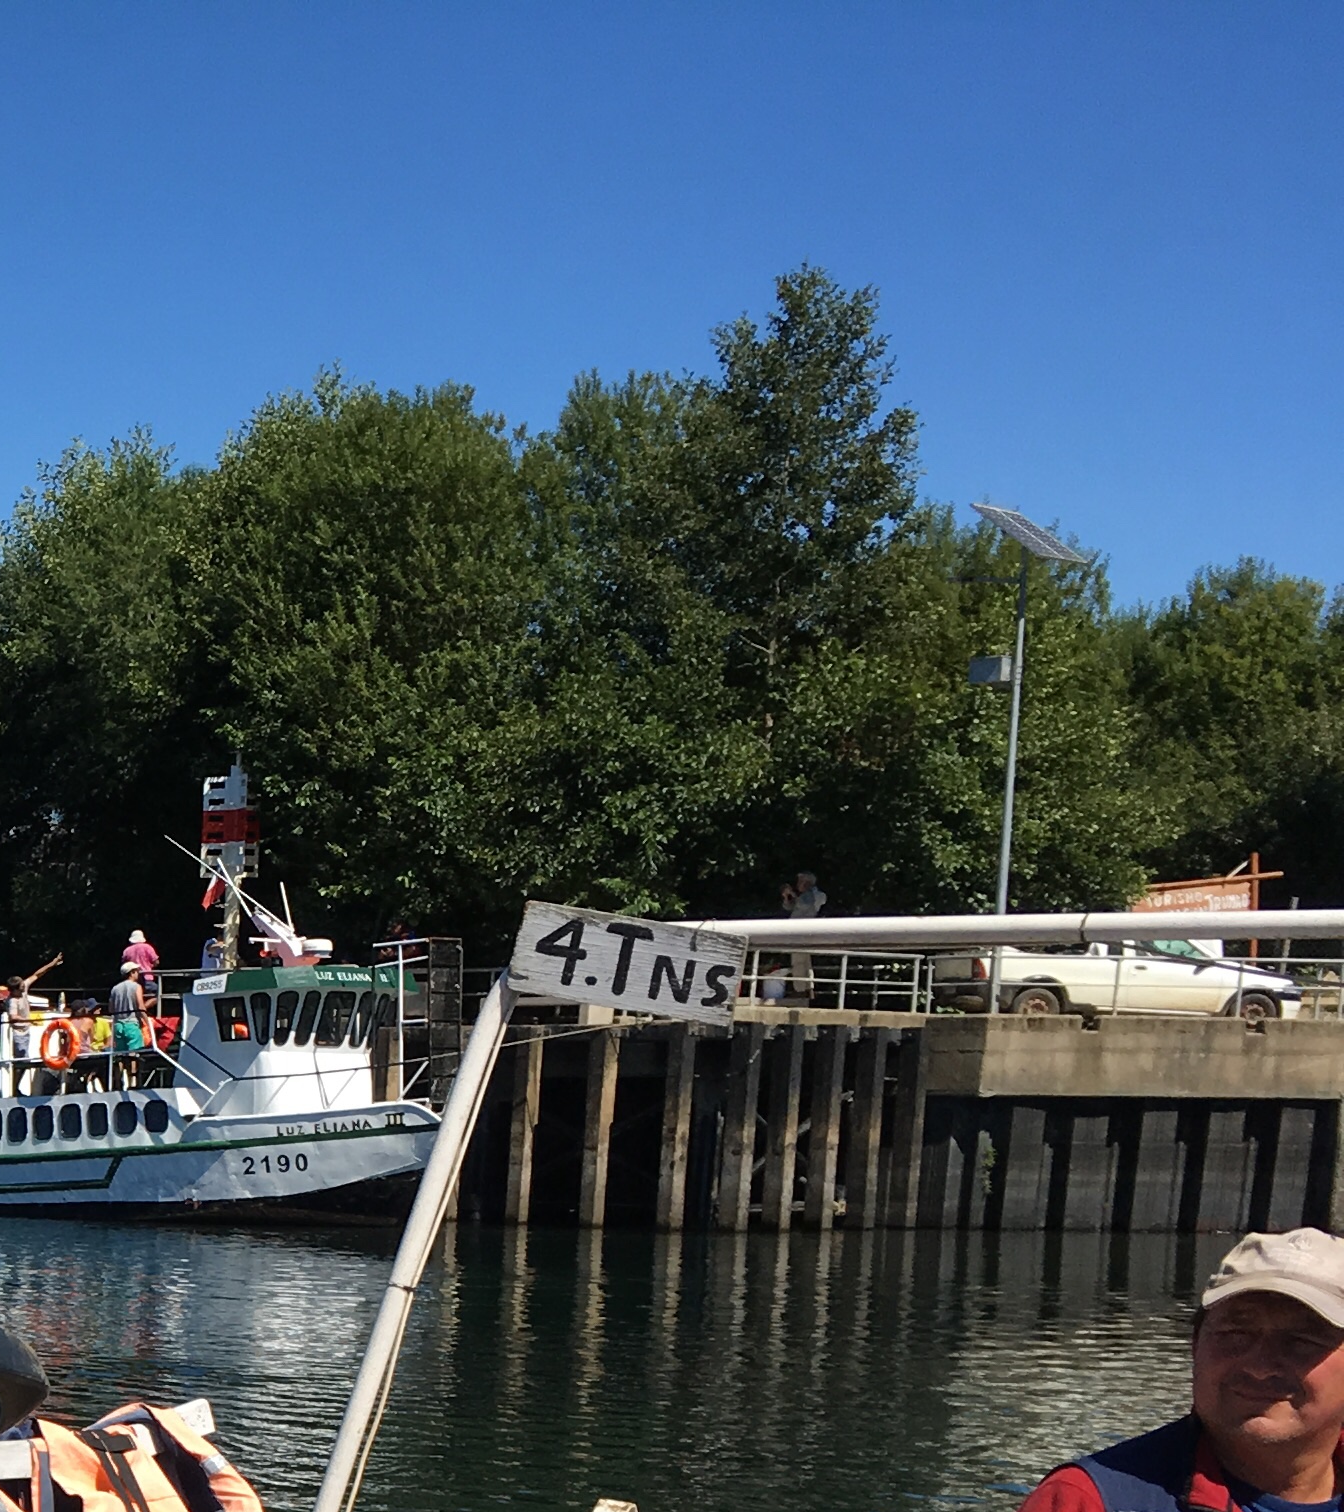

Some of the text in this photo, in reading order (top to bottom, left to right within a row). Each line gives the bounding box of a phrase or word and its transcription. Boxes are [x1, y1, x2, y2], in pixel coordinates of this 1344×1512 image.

[315, 971, 334, 981] LUZ
[336, 972, 372, 982] ELIANA
[276, 1125, 305, 1137] LUZ
[314, 1119, 372, 1134] ELIANA
[242, 1153, 308, 1175] 2190
